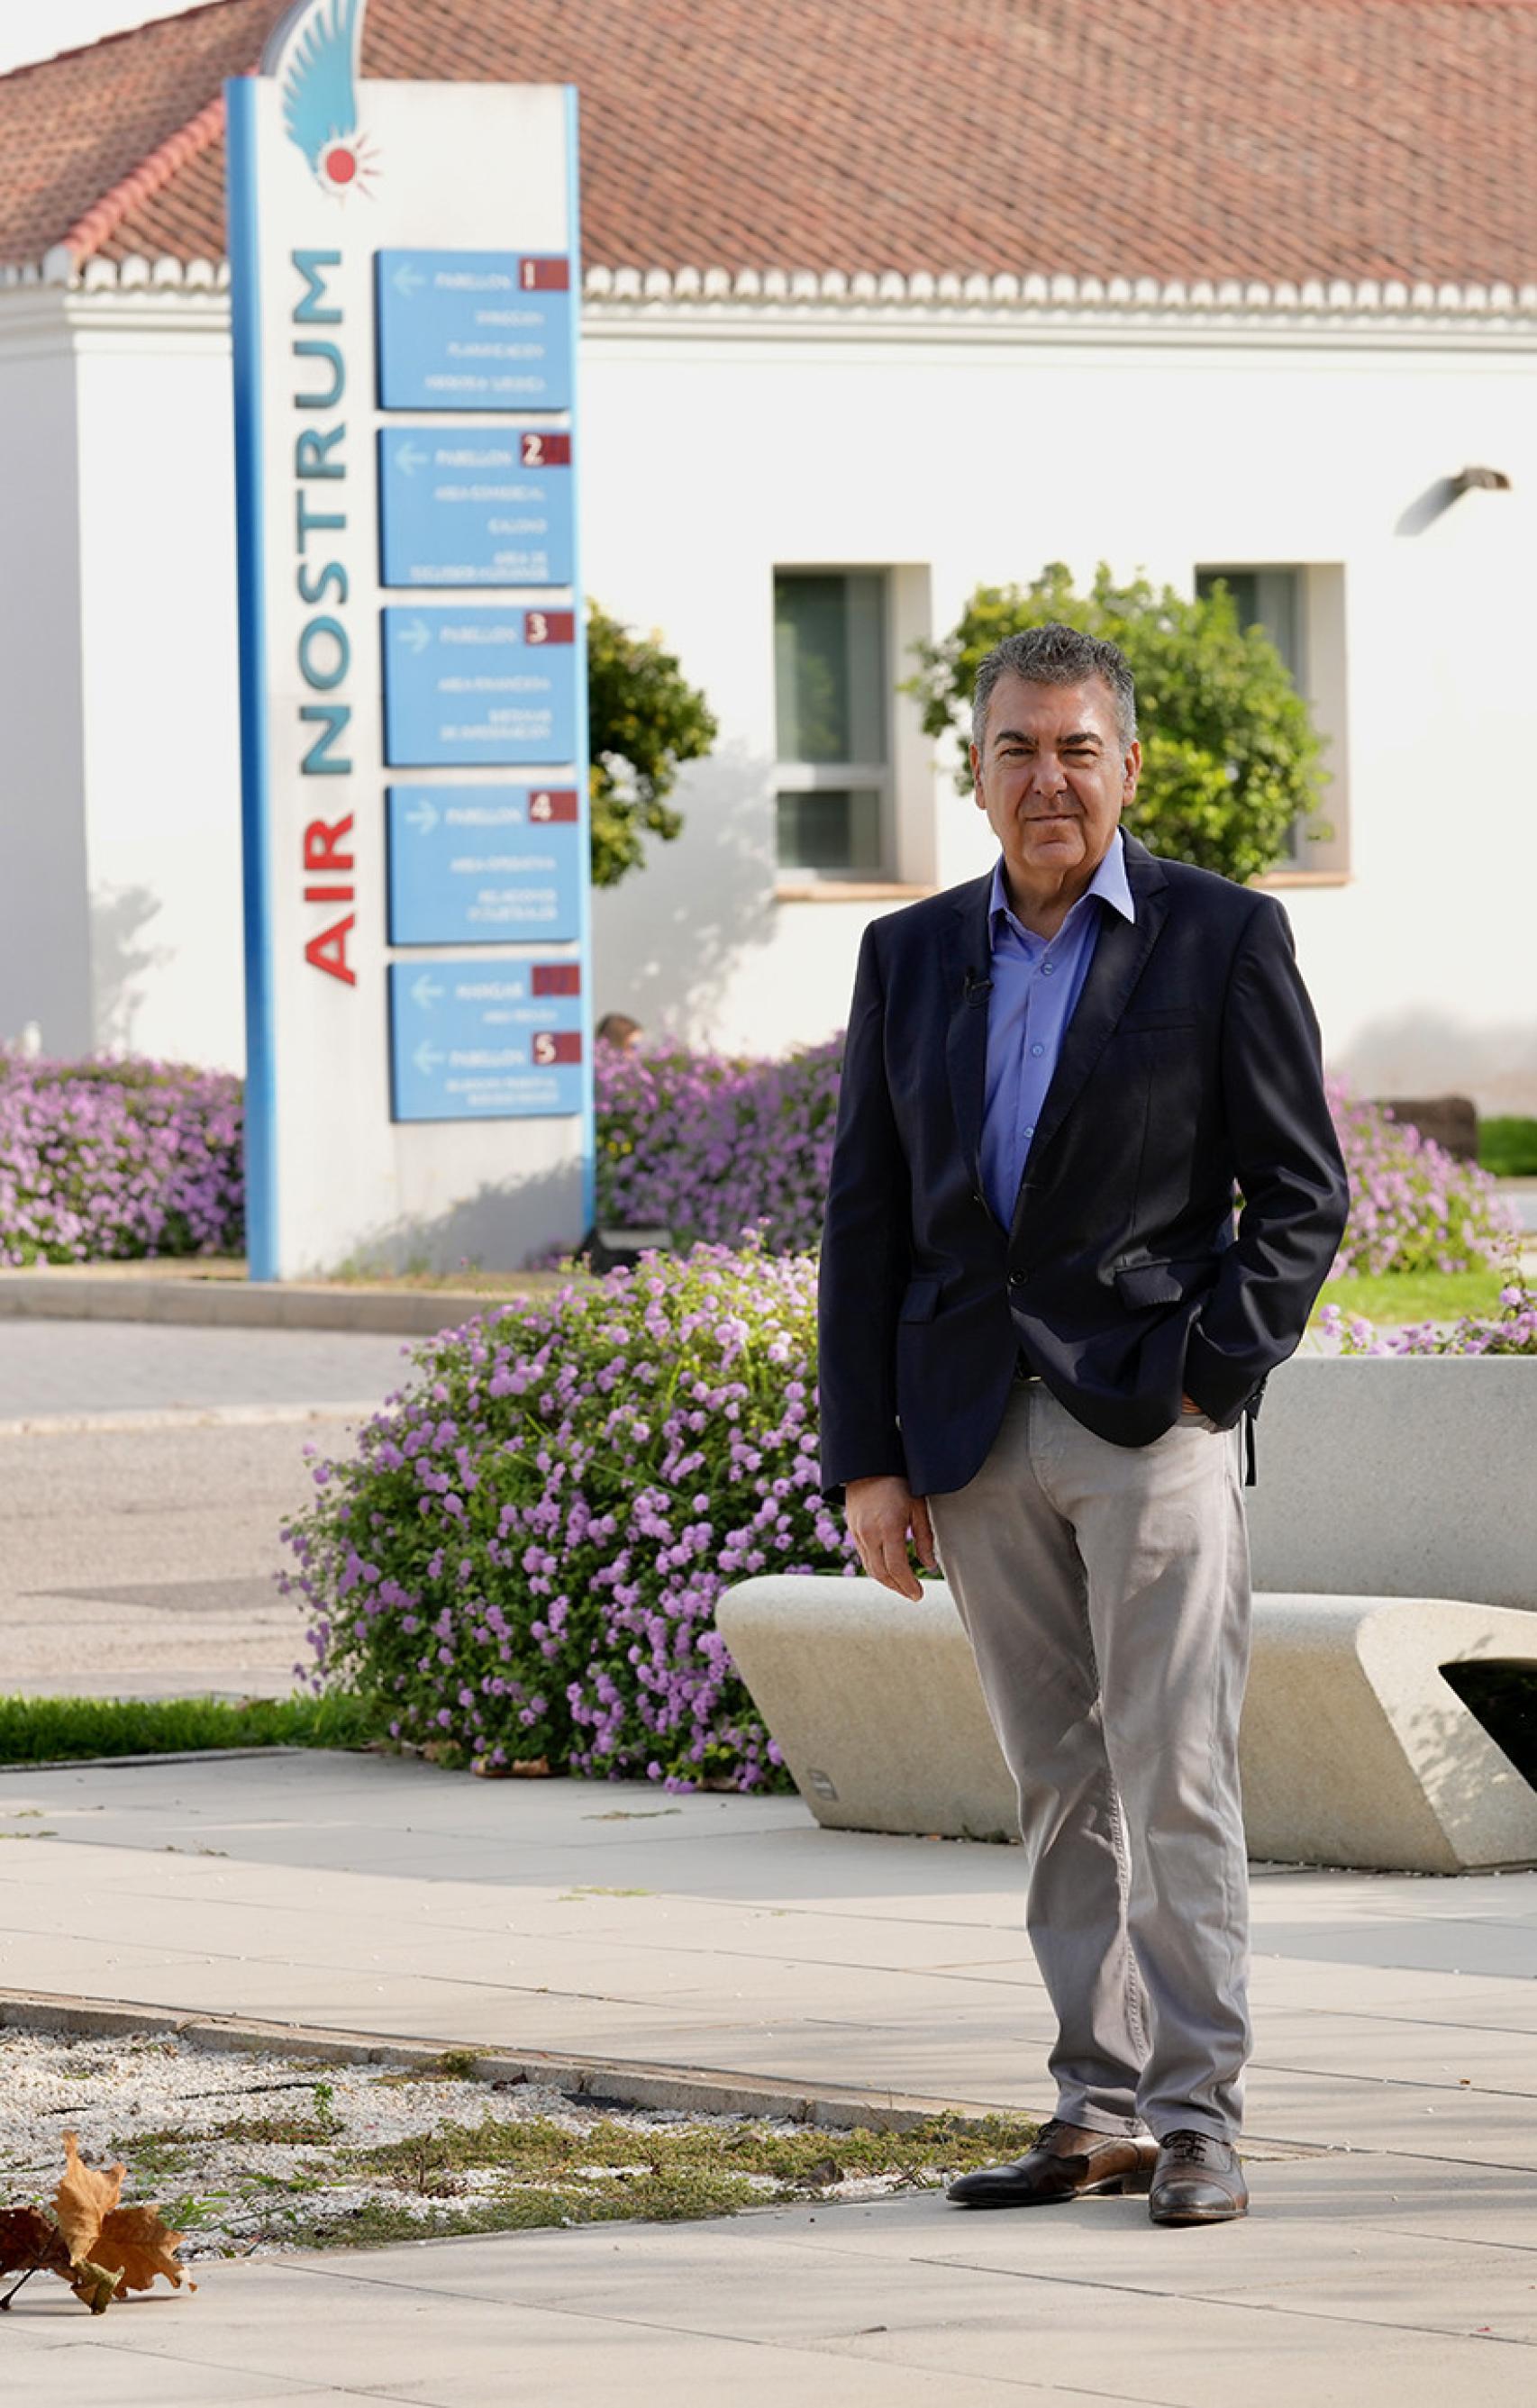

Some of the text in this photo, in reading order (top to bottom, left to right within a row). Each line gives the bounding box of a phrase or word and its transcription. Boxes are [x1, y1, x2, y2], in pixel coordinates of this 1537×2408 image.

[523, 261, 535, 287] 1
[523, 433, 544, 466] 2
[292, 250, 357, 987] AIR NOSTRUM
[526, 613, 548, 643] 3
[531, 793, 552, 821] 4
[535, 1032, 557, 1064] 5
